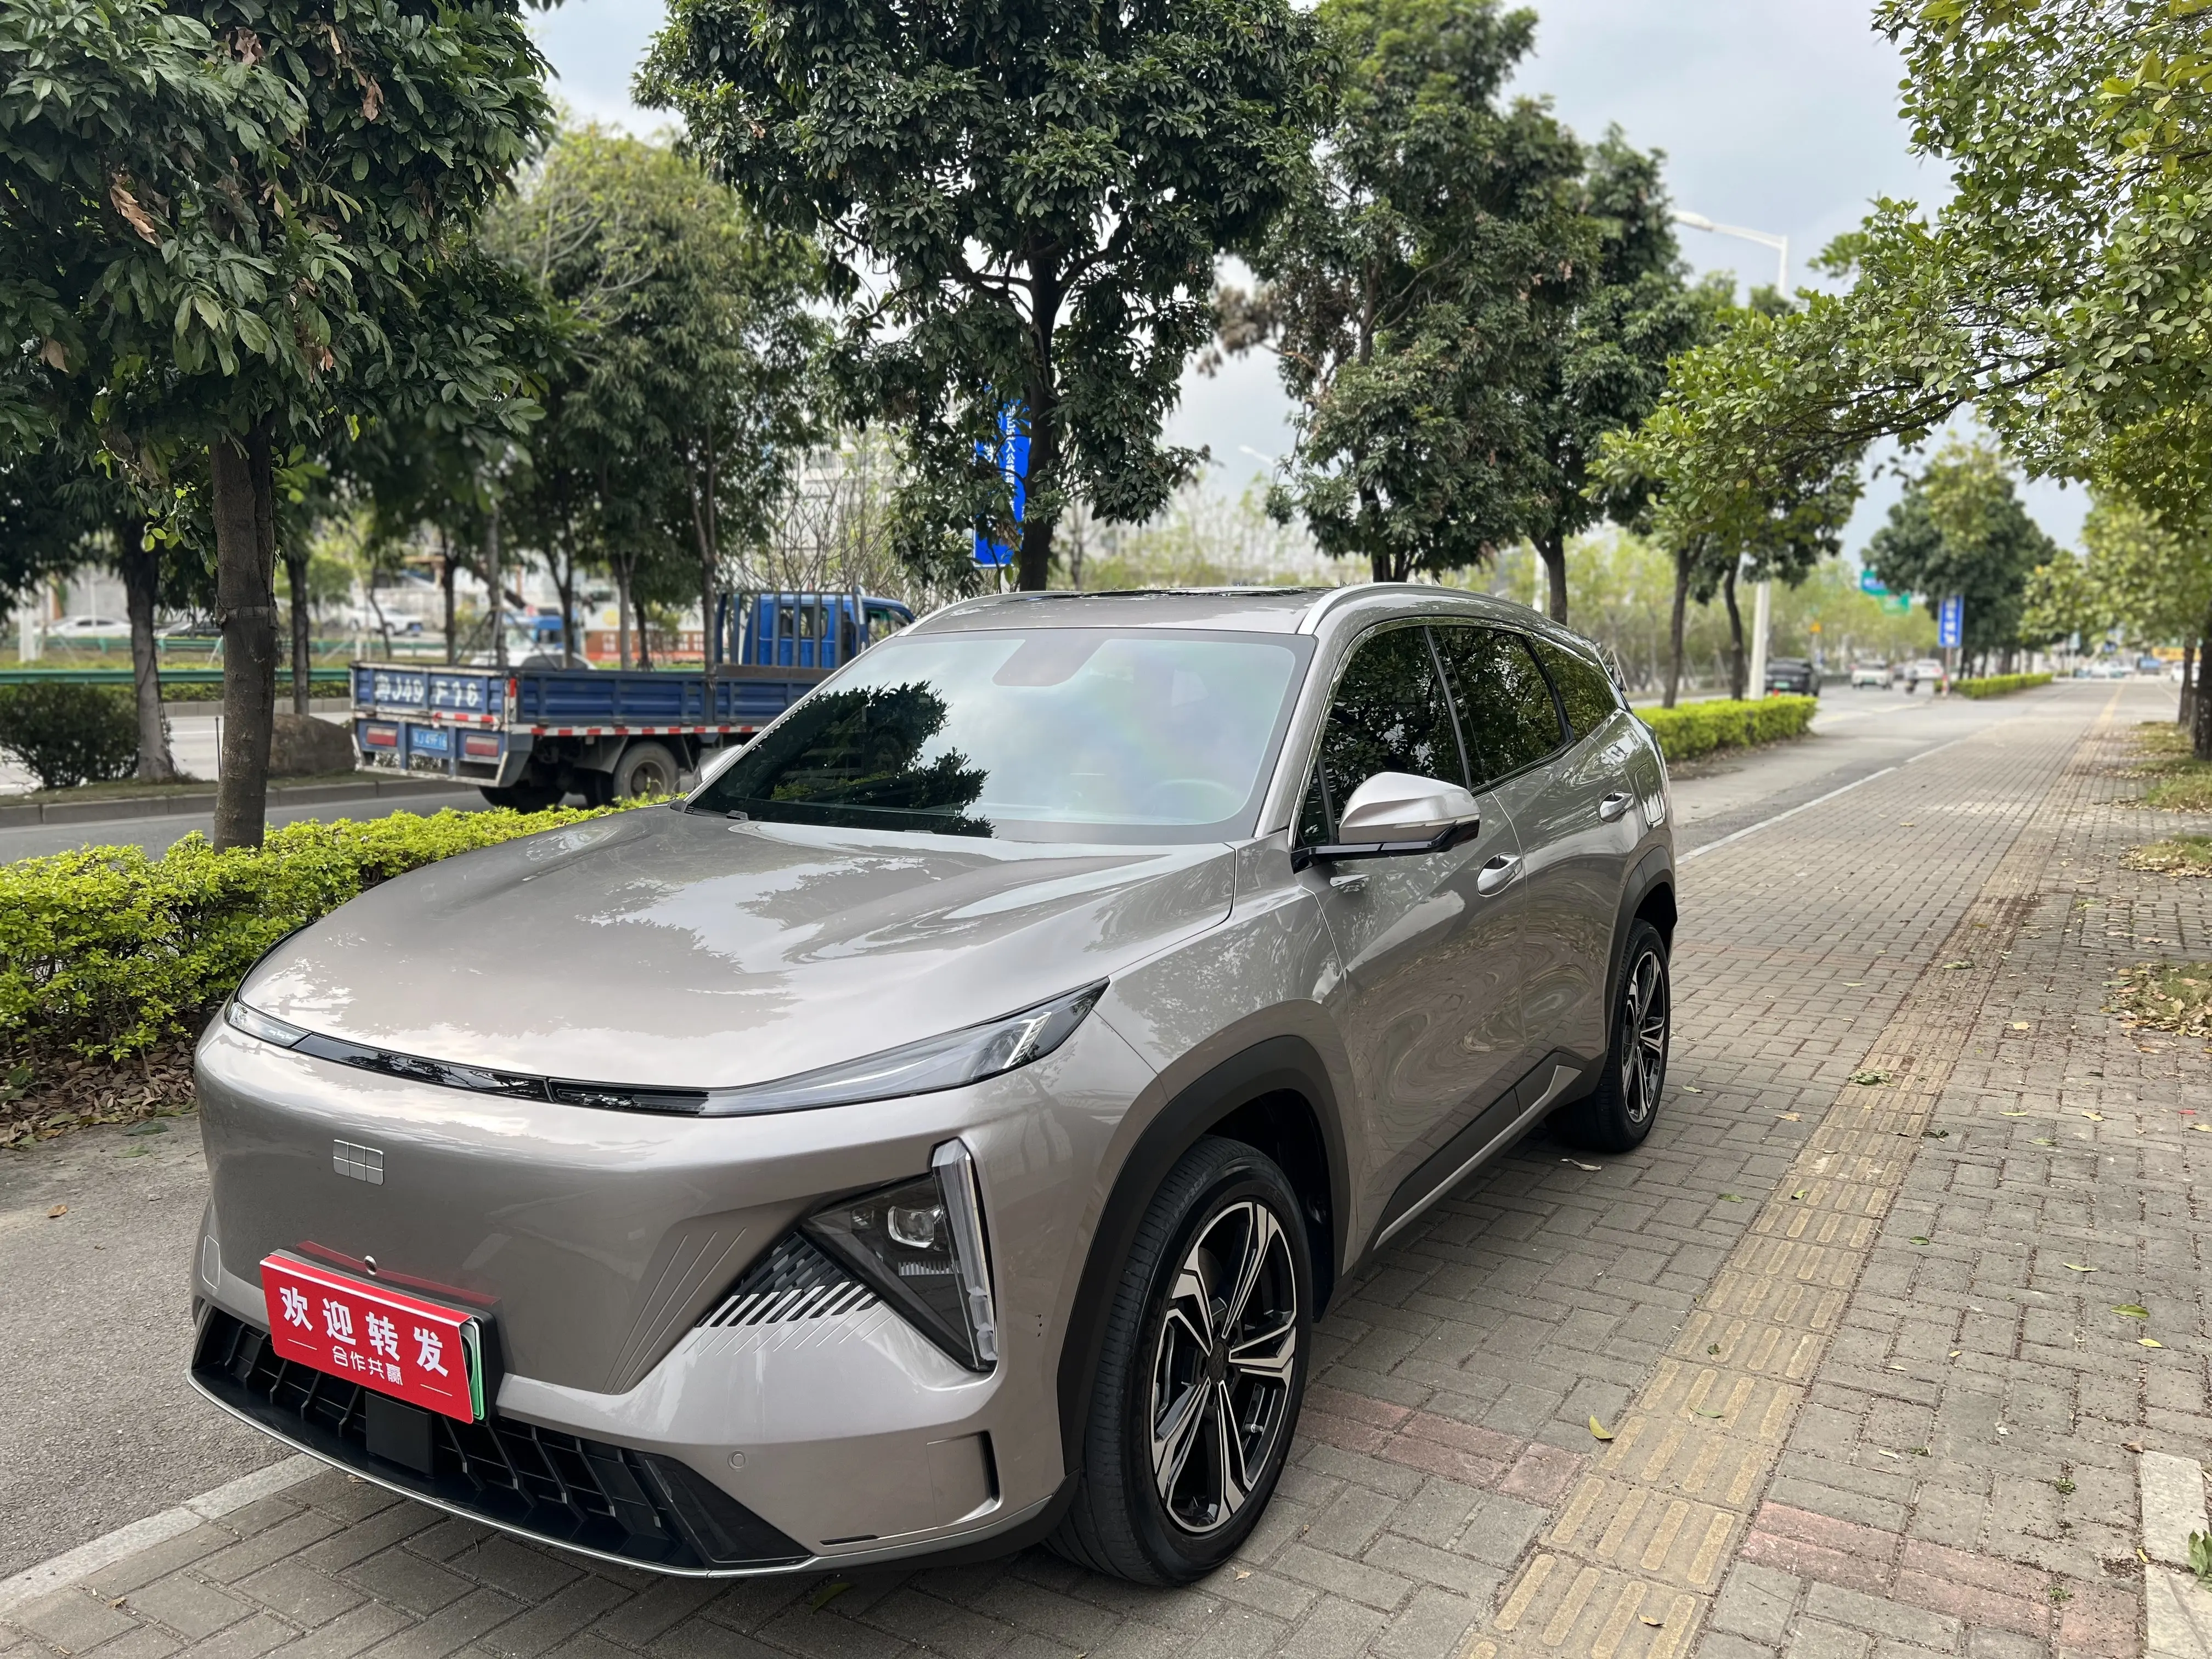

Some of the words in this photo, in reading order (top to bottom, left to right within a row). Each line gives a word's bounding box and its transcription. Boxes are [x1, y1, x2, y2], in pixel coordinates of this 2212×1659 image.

[279, 1286, 449, 1377] 欢迎转发
[332, 1345, 403, 1386] 合作共赢
